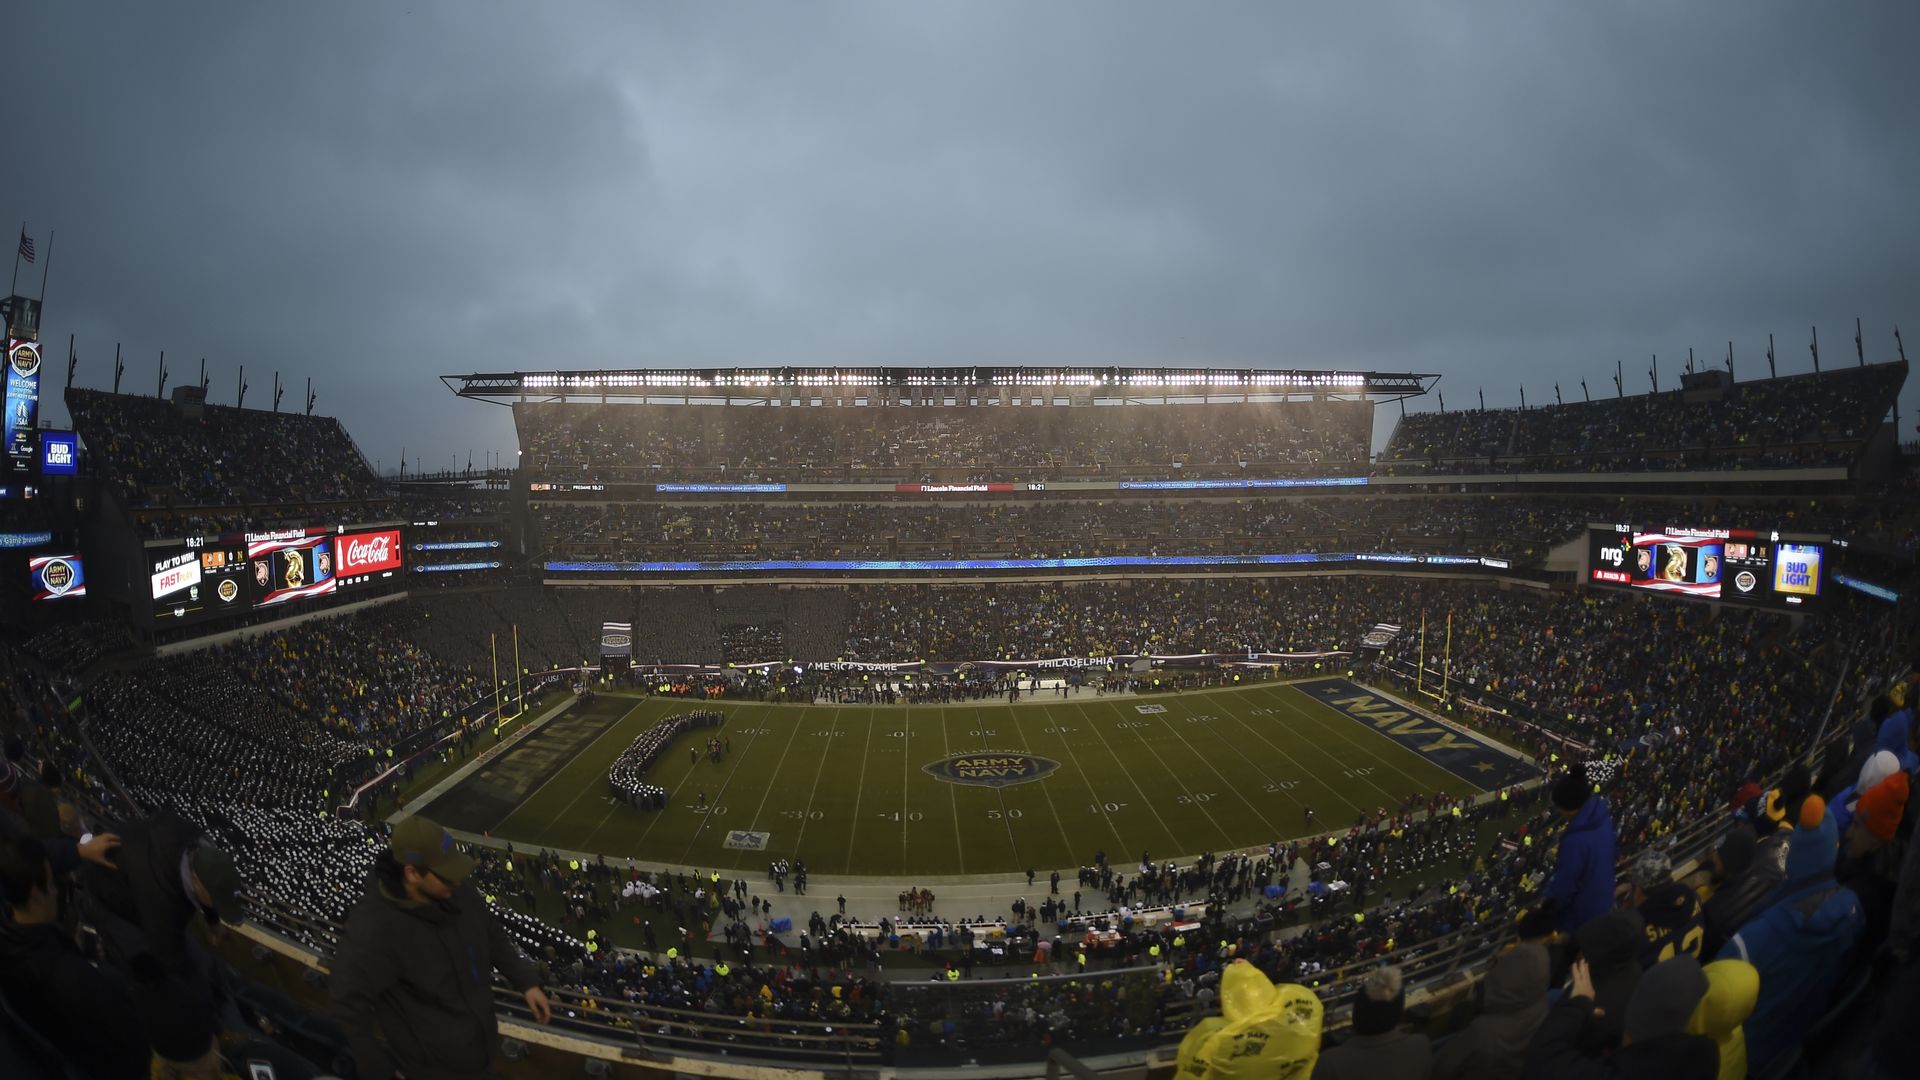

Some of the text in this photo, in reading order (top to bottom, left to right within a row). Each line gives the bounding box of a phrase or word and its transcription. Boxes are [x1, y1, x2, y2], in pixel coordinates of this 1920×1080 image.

[10, 379, 37, 389] WELCOME
[51, 444, 68, 454] BUD
[48, 454, 71, 464] LIGHT
[251, 529, 305, 541] Lincoln Financial Field
[1672, 527, 1729, 538] Lincoln Financial Field
[186, 537, 204, 548] 18:21
[155, 551, 195, 572] PLAY TO WIN!
[228, 552, 233, 561] 0
[1601, 547, 1623, 566] nrg
[49, 565, 65, 573] ARMY
[1786, 562, 1807, 573] BUD
[50, 576, 66, 585] NAVY
[1782, 574, 1810, 586] LIGHT
[807, 662, 897, 671] AMERICA'S GAME
[1038, 656, 1114, 668] PHILADELPHIA
[1330, 695, 1480, 753] NAVY
[955, 757, 1023, 767] ARMY
[960, 768, 1026, 777] NAVY
[1344, 767, 1370, 778] 10
[1264, 781, 1294, 793] 20
[1177, 792, 1210, 804] 30
[987, 809, 1023, 819] 50
